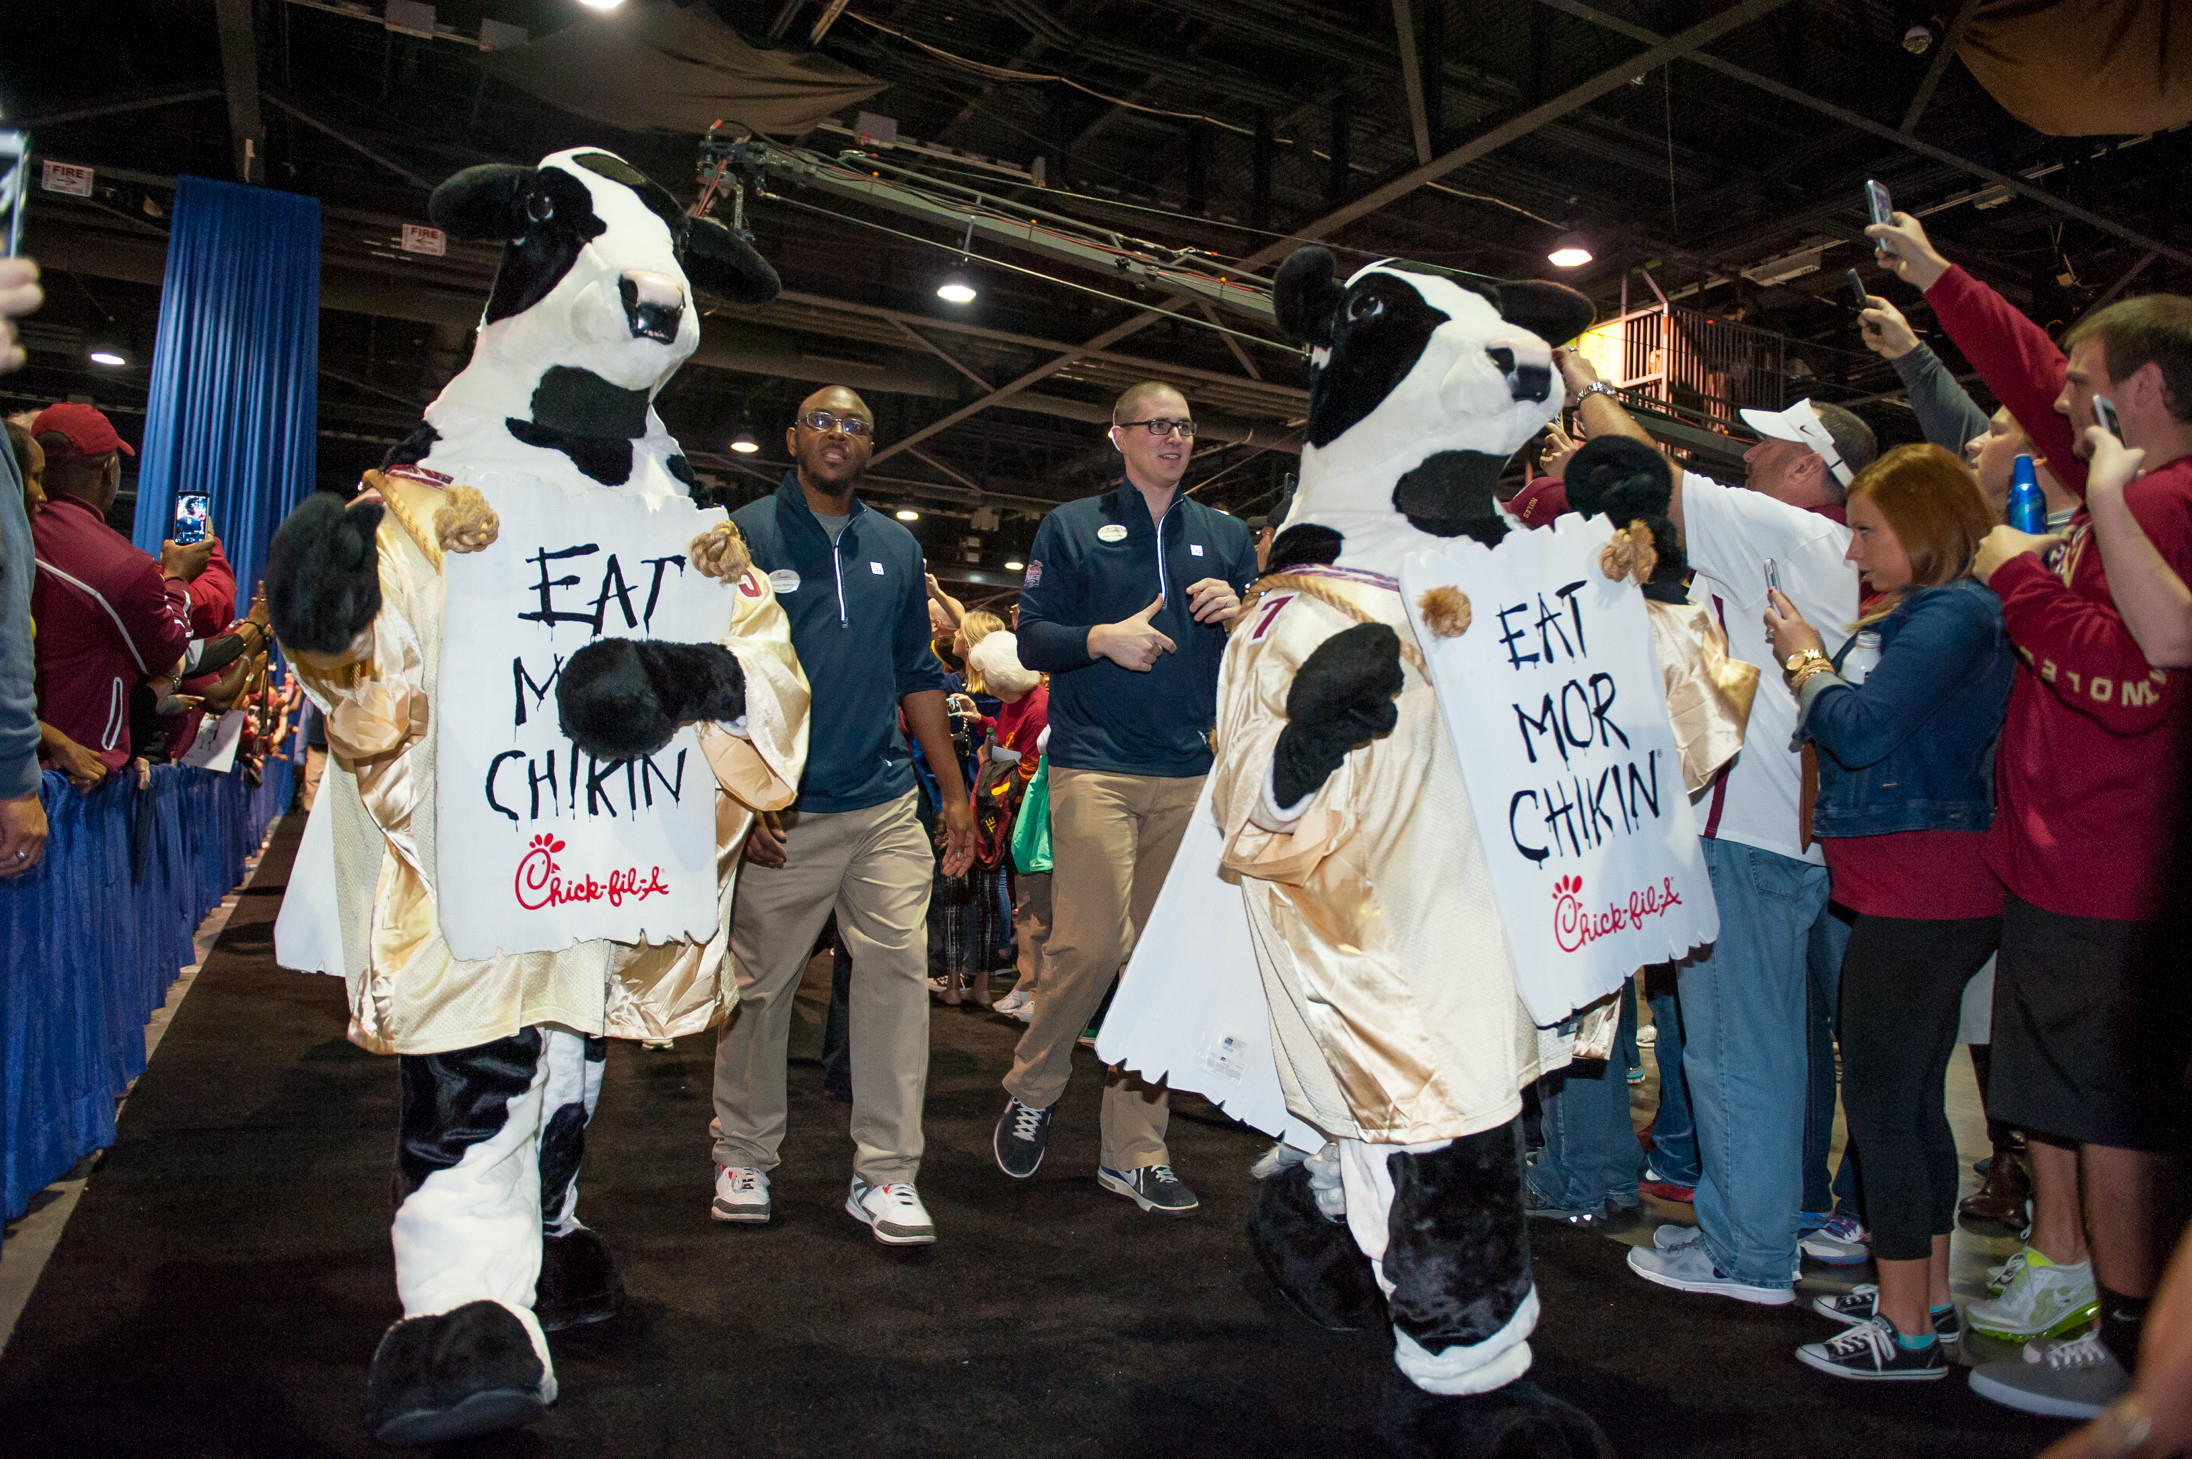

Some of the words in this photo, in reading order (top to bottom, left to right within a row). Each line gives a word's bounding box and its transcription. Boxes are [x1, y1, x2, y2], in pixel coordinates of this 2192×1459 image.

[52, 165, 84, 179] FIRE
[410, 227, 438, 239] FIRE
[1523, 497, 1539, 519] NOLES
[517, 543, 687, 638] EAT
[1252, 595, 1295, 640] 7
[1496, 580, 1588, 671] EAT
[1512, 672, 1631, 768] MOR
[485, 742, 688, 831] CHIKIN
[1510, 750, 1661, 869] CHIKIN
[514, 833, 670, 911] Chick-fil-A
[1552, 875, 1683, 953] Chick-fil-A
